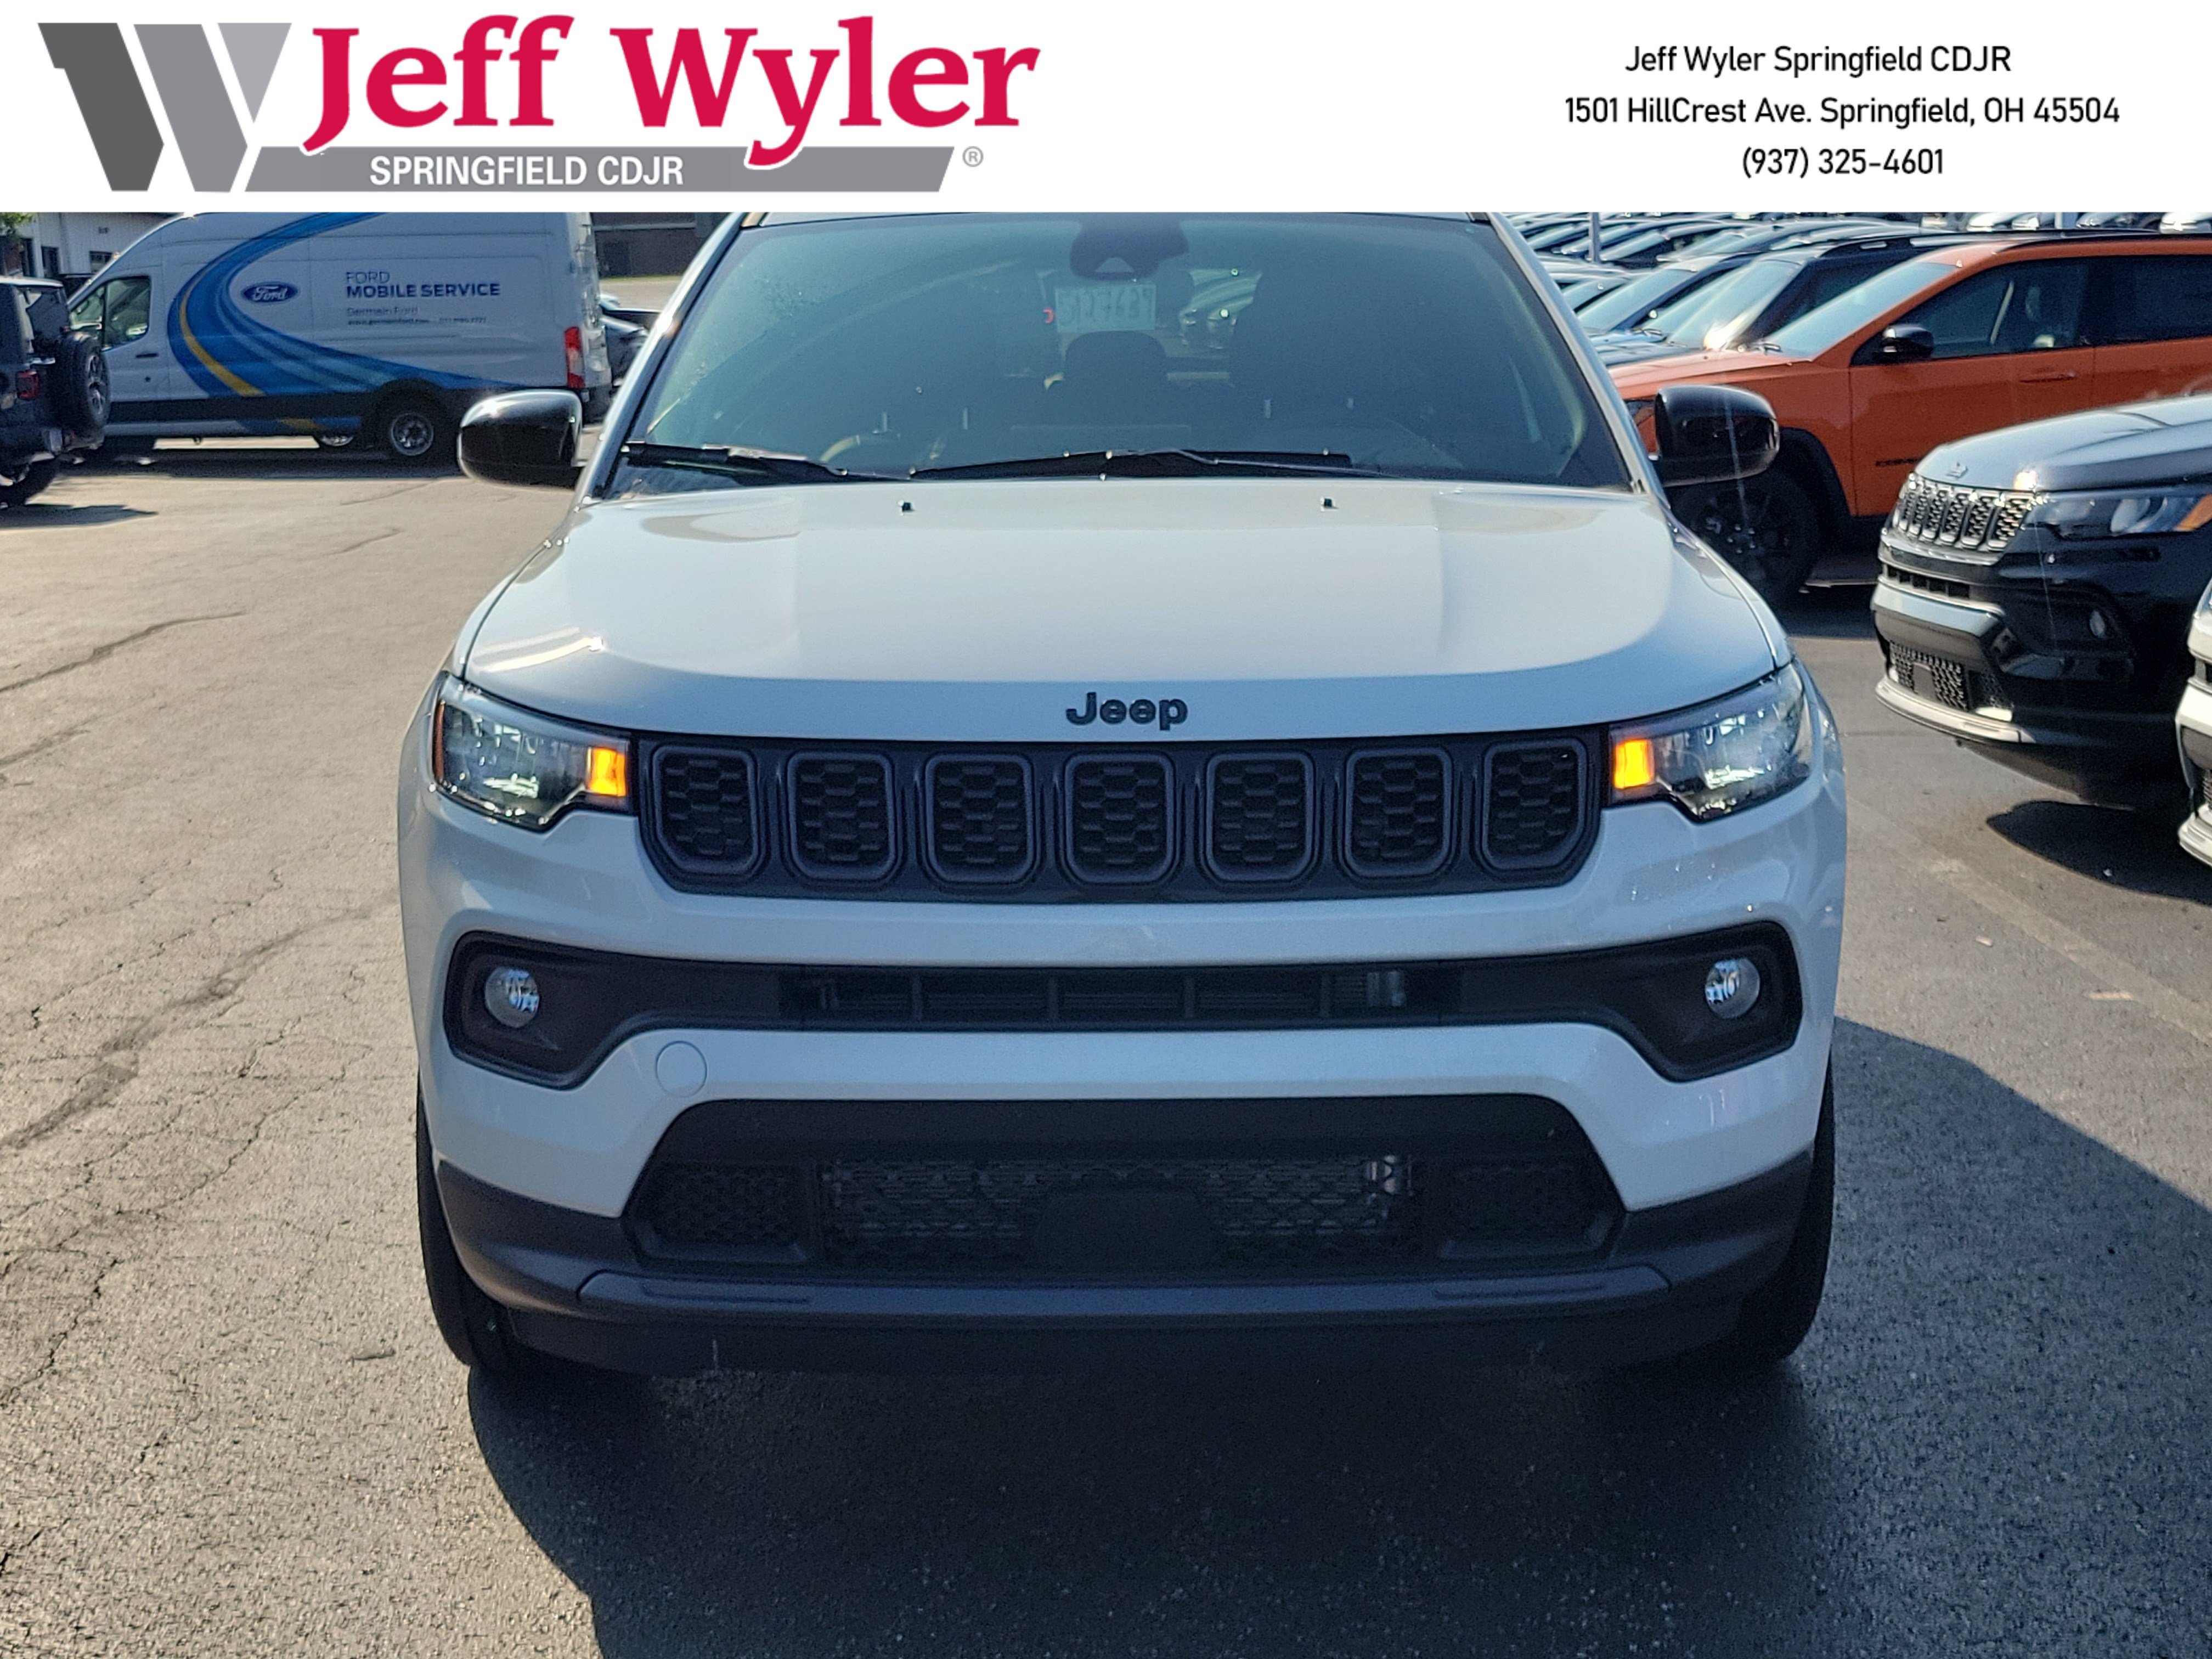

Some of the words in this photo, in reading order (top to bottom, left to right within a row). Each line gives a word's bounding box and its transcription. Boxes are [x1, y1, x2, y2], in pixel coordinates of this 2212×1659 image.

[346, 271, 391, 284] FORD
[252, 286, 288, 301] Ford
[346, 284, 417, 298] MOBILE
[421, 283, 501, 297] SERVICE
[1065, 691, 1189, 731] Jeep
